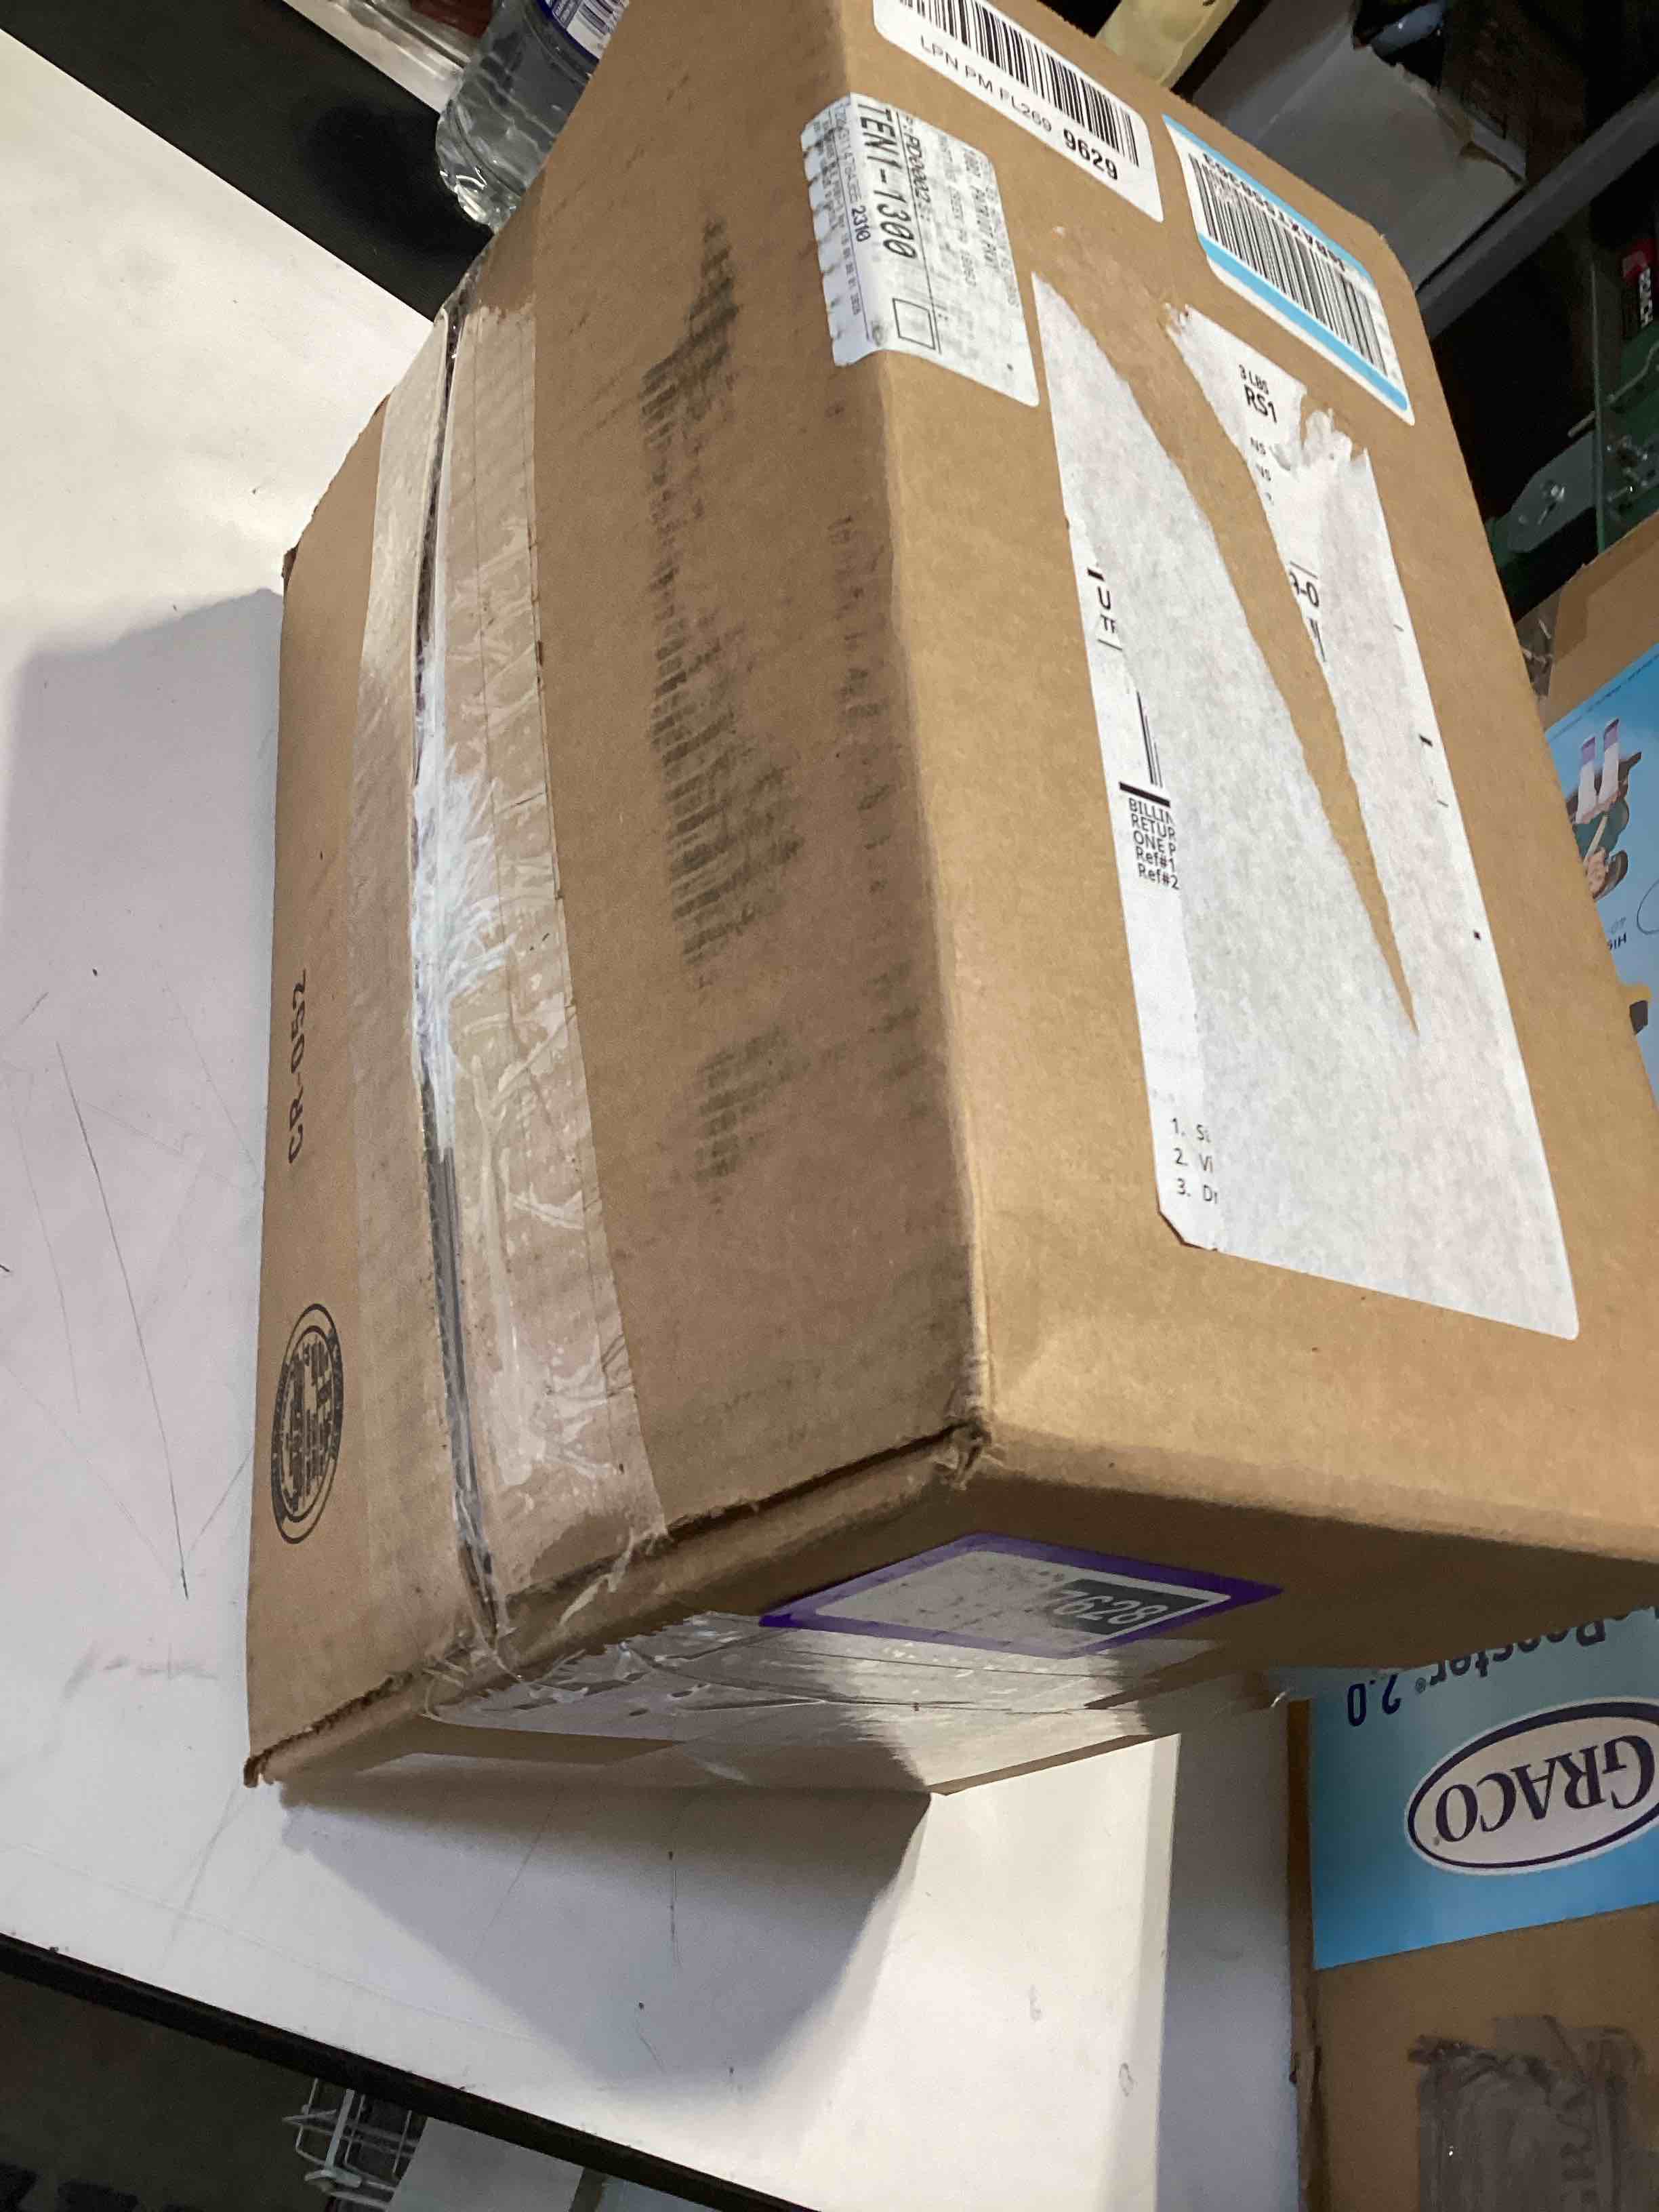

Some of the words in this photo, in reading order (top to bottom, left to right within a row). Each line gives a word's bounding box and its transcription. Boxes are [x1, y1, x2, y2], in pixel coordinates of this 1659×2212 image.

[921, 35, 958, 70] LPN
[1063, 128, 1118, 180] 9629
[1133, 830, 1166, 854] ONE
[1346, 1673, 1402, 1727] 2.0
[1435, 1734, 1656, 1843] GRACO
